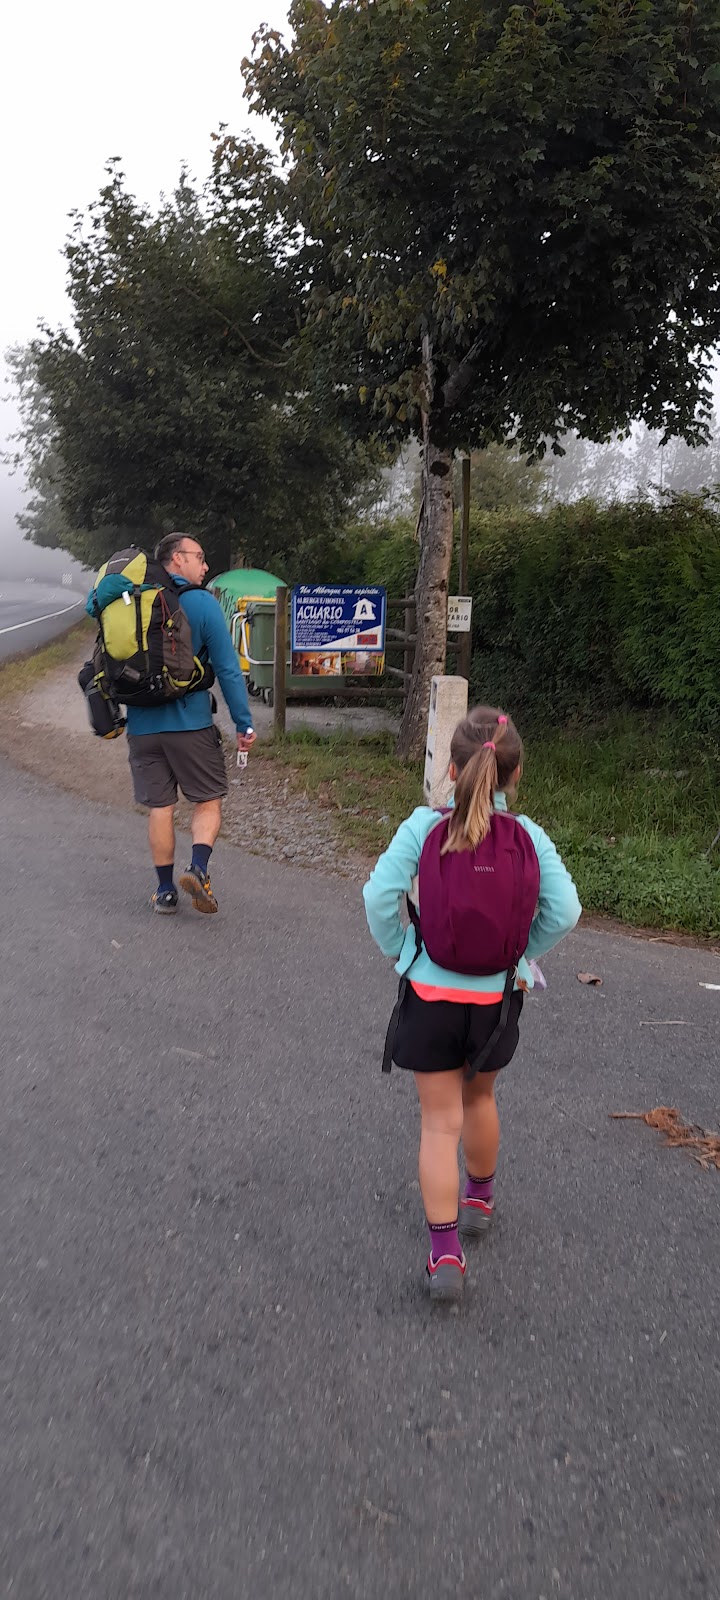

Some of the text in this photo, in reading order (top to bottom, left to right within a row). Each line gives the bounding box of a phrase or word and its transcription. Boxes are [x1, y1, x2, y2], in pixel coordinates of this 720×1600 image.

[299, 586, 311, 595] Un
[312, 586, 341, 596] Albergue
[297, 606, 343, 620] ACUARIO
